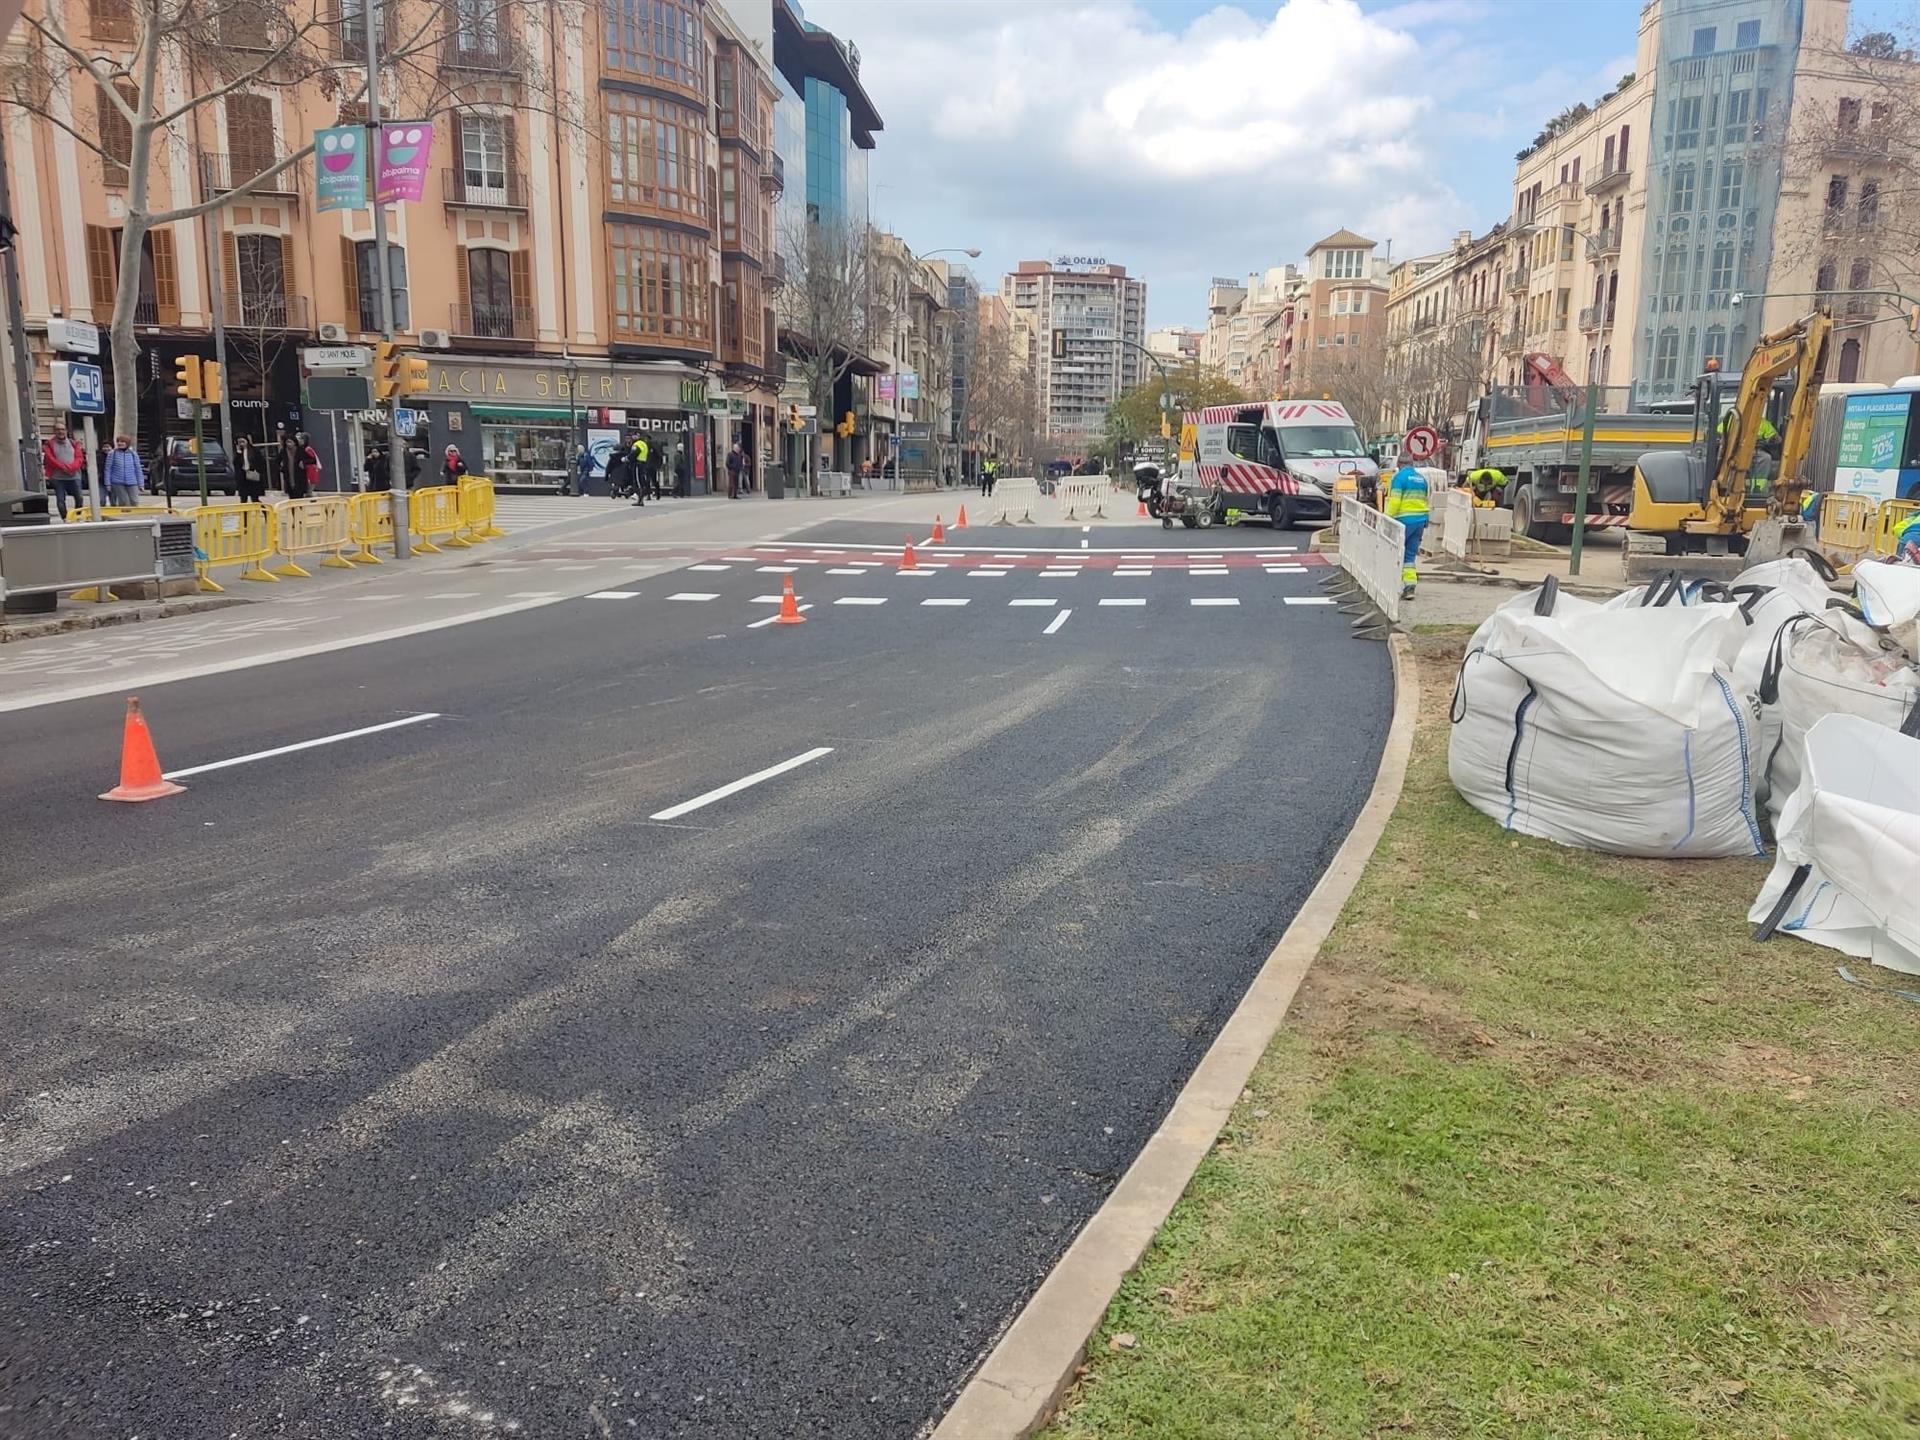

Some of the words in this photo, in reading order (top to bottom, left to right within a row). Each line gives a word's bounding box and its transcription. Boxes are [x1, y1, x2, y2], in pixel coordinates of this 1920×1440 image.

[1073, 256, 1106, 265] OCASO
[535, 372, 633, 399] SBERT
[230, 399, 270, 409] arume
[639, 418, 689, 432] OPTICA
[1845, 420, 1866, 430] Ahorra
[1841, 442, 1863, 452] factura
[1871, 439, 1894, 458] 70%
